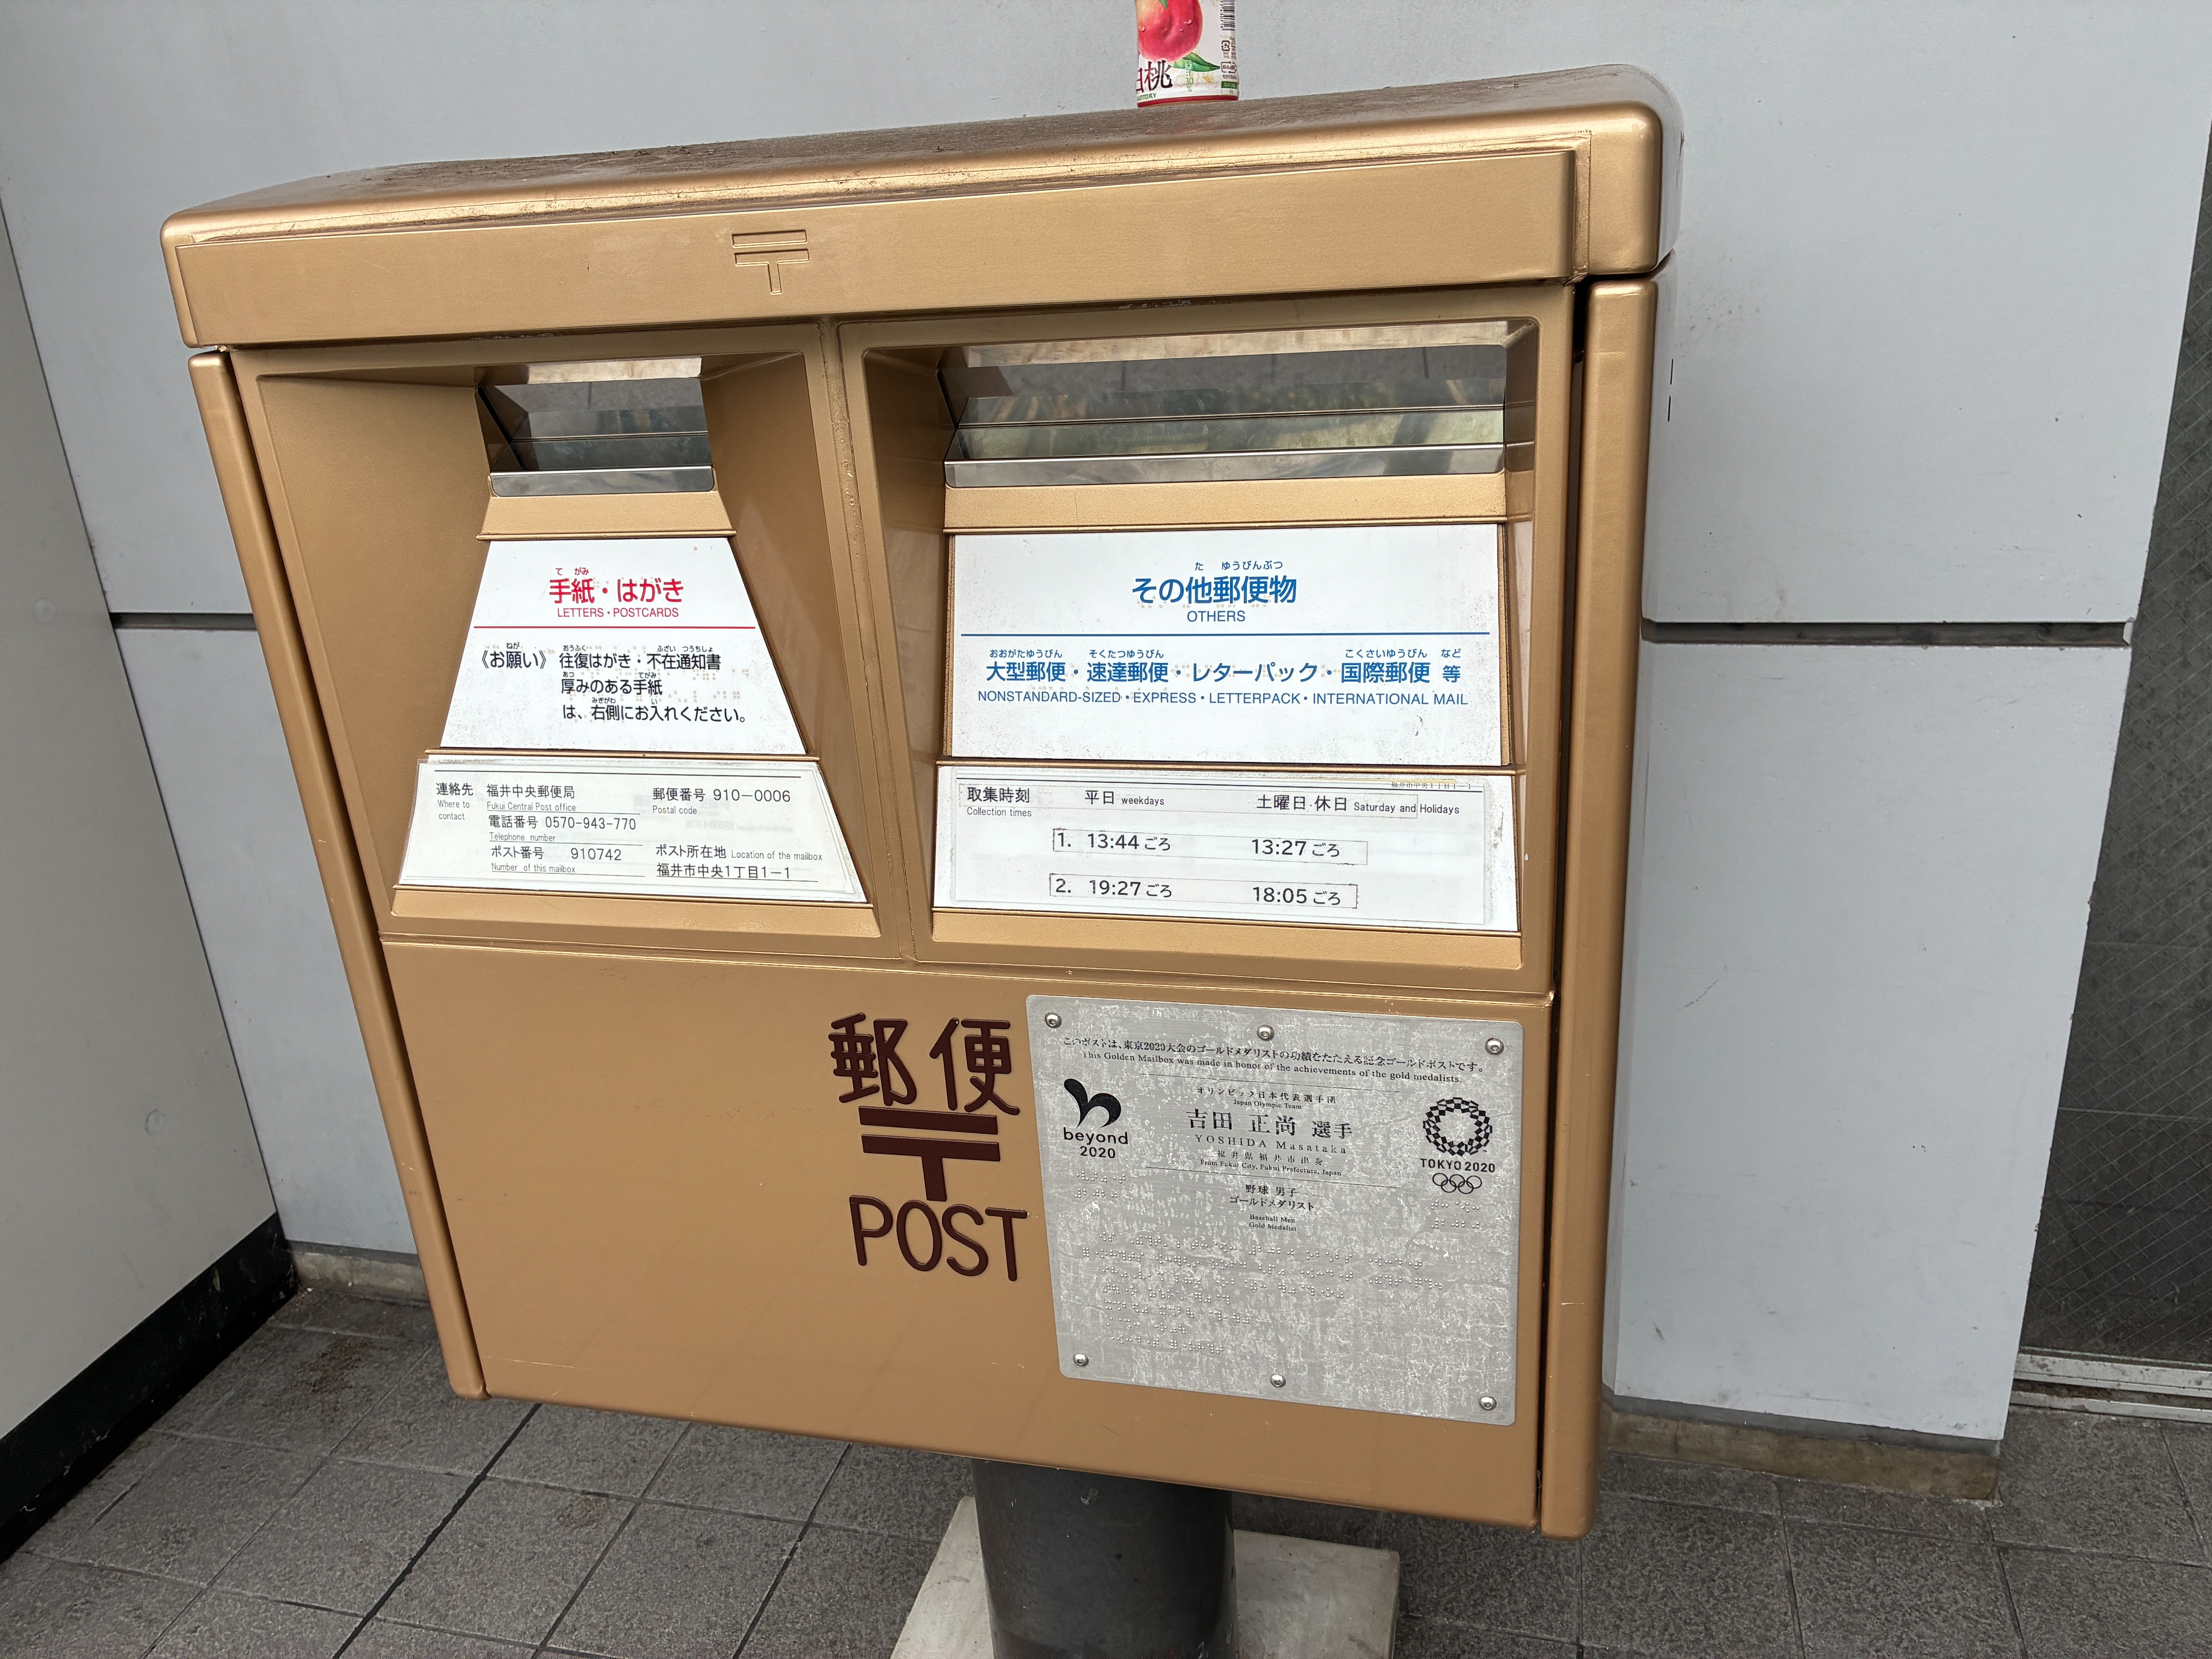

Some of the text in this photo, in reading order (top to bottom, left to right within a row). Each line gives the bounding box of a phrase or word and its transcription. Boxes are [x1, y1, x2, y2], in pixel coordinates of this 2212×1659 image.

[574, 567, 589, 575] がみ
[1195, 562, 1204, 571] た
[549, 578, 684, 604] 手紙・はがき
[1132, 575, 1297, 604] その他郵便物
[1187, 610, 1245, 622] OTHERS
[990, 649, 1461, 659] おおがたゆうびん そくたつゆうびん こくさいゆうびん など
[562, 678, 663, 695] 厚みのある手紙
[1434, 694, 1468, 705] MAIL
[563, 704, 745, 723] は、右側にお入れください。
[436, 782, 474, 797] 連絡先
[486, 784, 575, 799] 福井中央郵便局
[653, 787, 706, 802] 郵便番号
[967, 787, 1030, 803] 取集時刻
[438, 800, 460, 808] Where
[1084, 790, 1164, 806] 平日 weekdays
[487, 801, 576, 811] Fukui Central Post office
[653, 805, 697, 814] Postal code
[967, 807, 1032, 817] Collection times
[1354, 802, 1395, 813] Saturday
[1400, 804, 1416, 812] and
[1420, 804, 1460, 815] Holidays
[439, 812, 465, 820] contact
[489, 815, 636, 830] 電話番号 0570-943-770
[489, 832, 525, 842] Telephone
[1057, 832, 1072, 847] 1.
[491, 846, 622, 861] ポスト番号 910742
[656, 844, 823, 861] ポスト所在地 Location of the mailbox
[491, 863, 575, 873] Number of this mailbox
[1056, 878, 1072, 893] 2.
[828, 1012, 1020, 1115] 郵便
[1082, 1051, 1101, 1060] This
[1104, 1052, 1135, 1062] Golden
[1138, 1054, 1174, 1064] Mailbox
[1197, 1058, 1221, 1067] made
[1236, 1060, 1261, 1069] honor
[1264, 1062, 1274, 1070] of
[1277, 1063, 1291, 1072] the
[1294, 1065, 1356, 1077] achievements
[1359, 1069, 1370, 1077] of
[1372, 1070, 1387, 1078] the
[1390, 1071, 1410, 1081] gold
[1413, 1072, 1462, 1083] medalists.
[1254, 1101, 1282, 1109] Olympic
[1186, 1108, 1353, 1139] 吉田 正尚 選手
[1063, 1127, 1128, 1145] beyond
[1195, 1135, 1346, 1154] YOSHIDA Masataka
[1080, 1146, 1116, 1159] 2020
[1322, 1169, 1341, 1177] Japan
[1420, 1158, 1495, 1173] TOKYO 2020
[1245, 1184, 1297, 1197] 野球 男子
[1230, 1195, 1314, 1211] ゴールドメダリスト
[1249, 1214, 1278, 1222] Baseball
[849, 1195, 1028, 1281] POST
